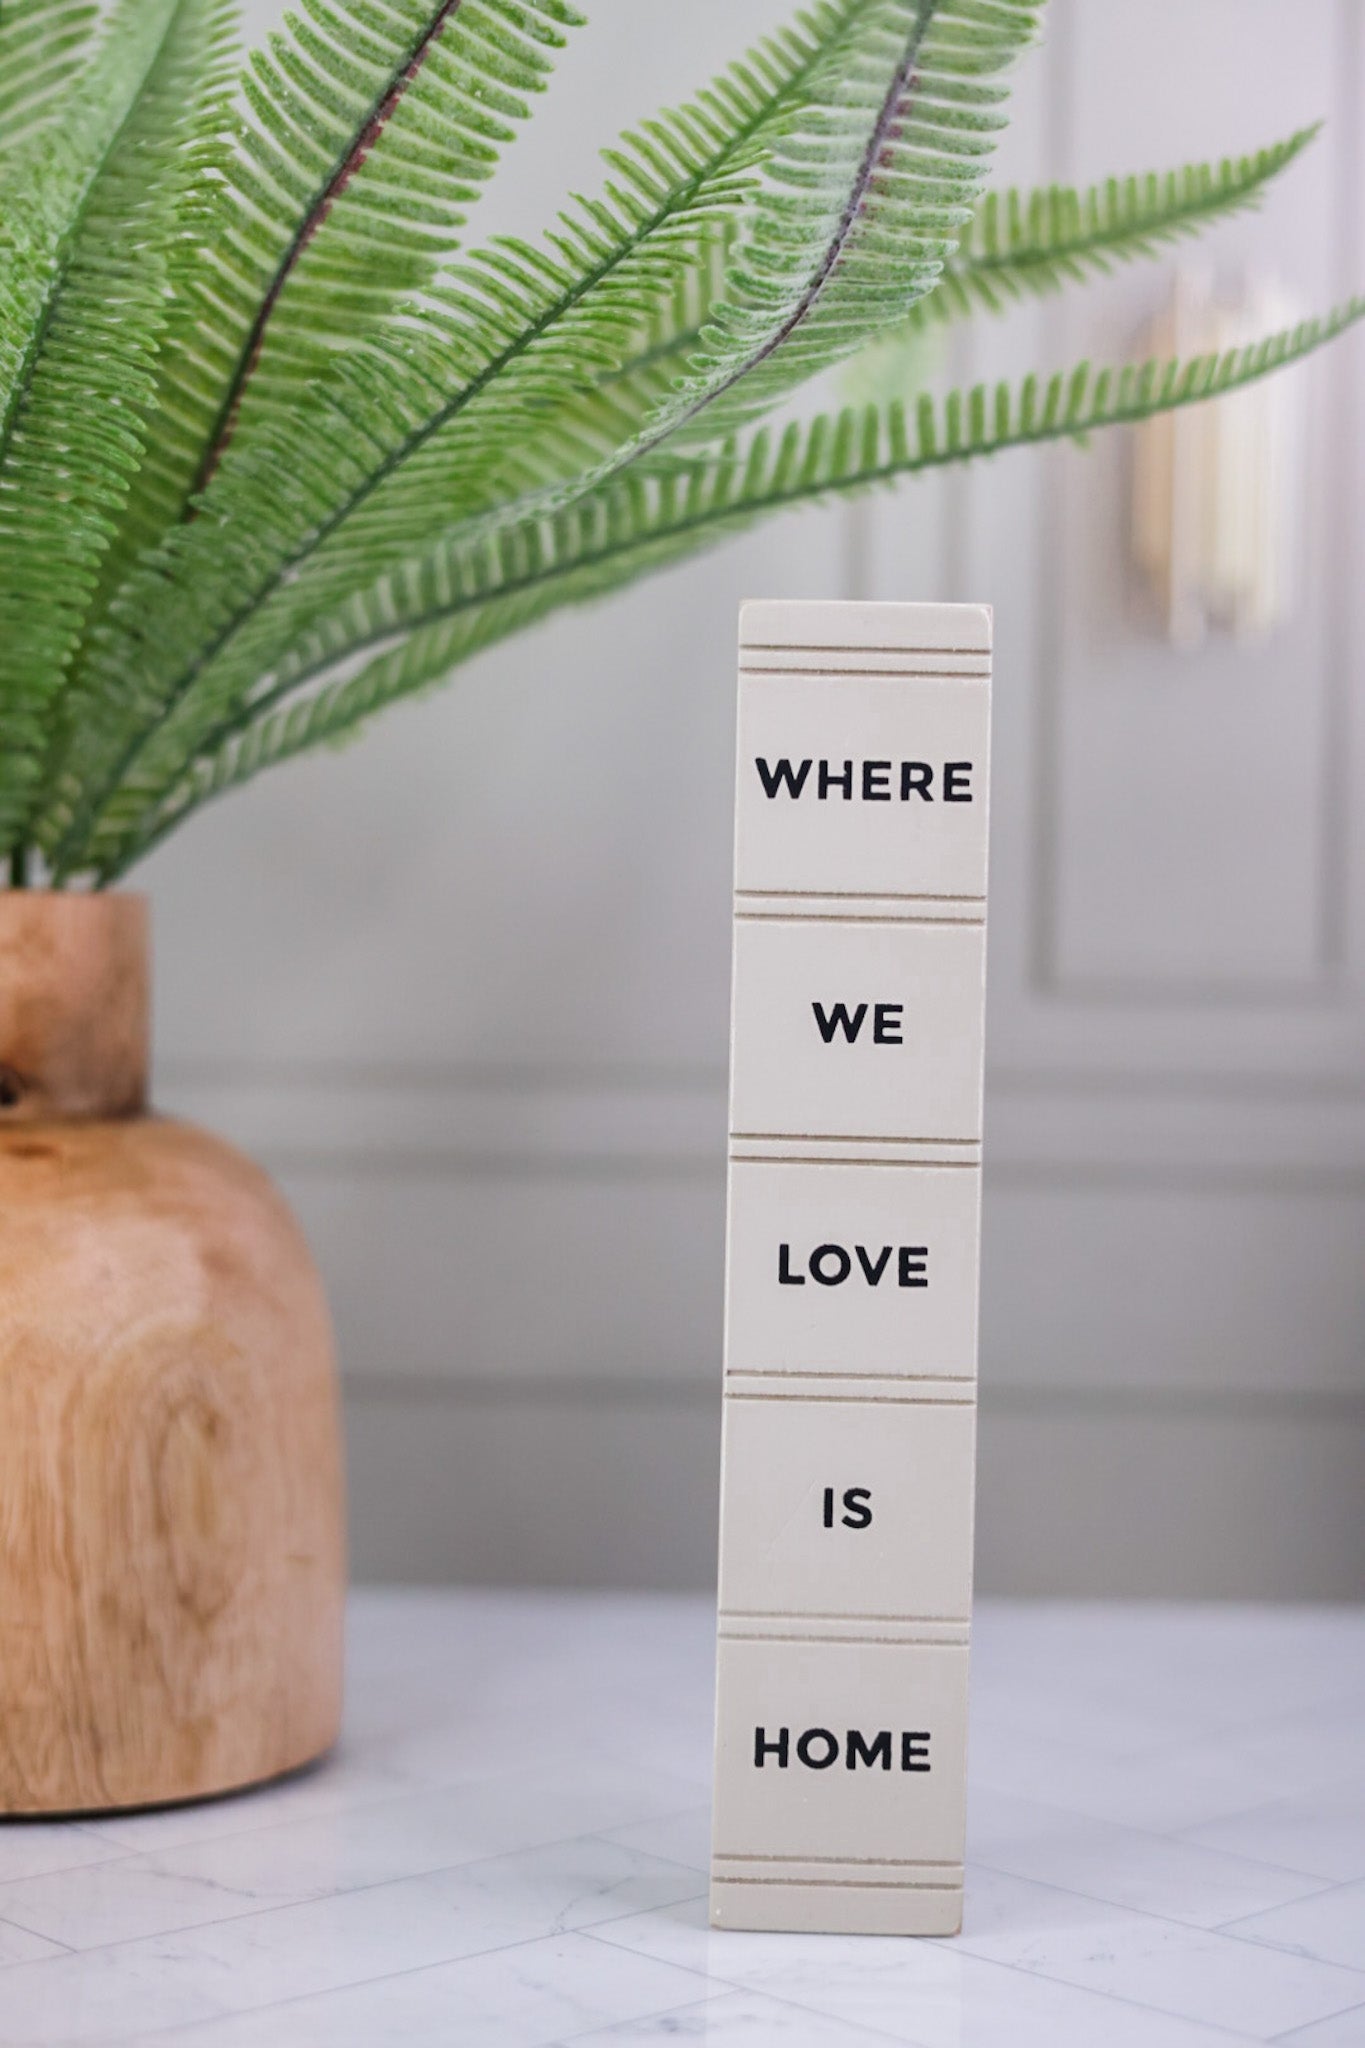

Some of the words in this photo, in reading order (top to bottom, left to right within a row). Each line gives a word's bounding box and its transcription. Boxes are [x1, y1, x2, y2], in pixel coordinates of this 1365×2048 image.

[755, 757, 973, 803] WHERE
[811, 1002, 904, 1045] WE
[778, 1243, 929, 1288] LOVE
[823, 1487, 873, 1530] IS
[754, 1726, 931, 1773] HOME
